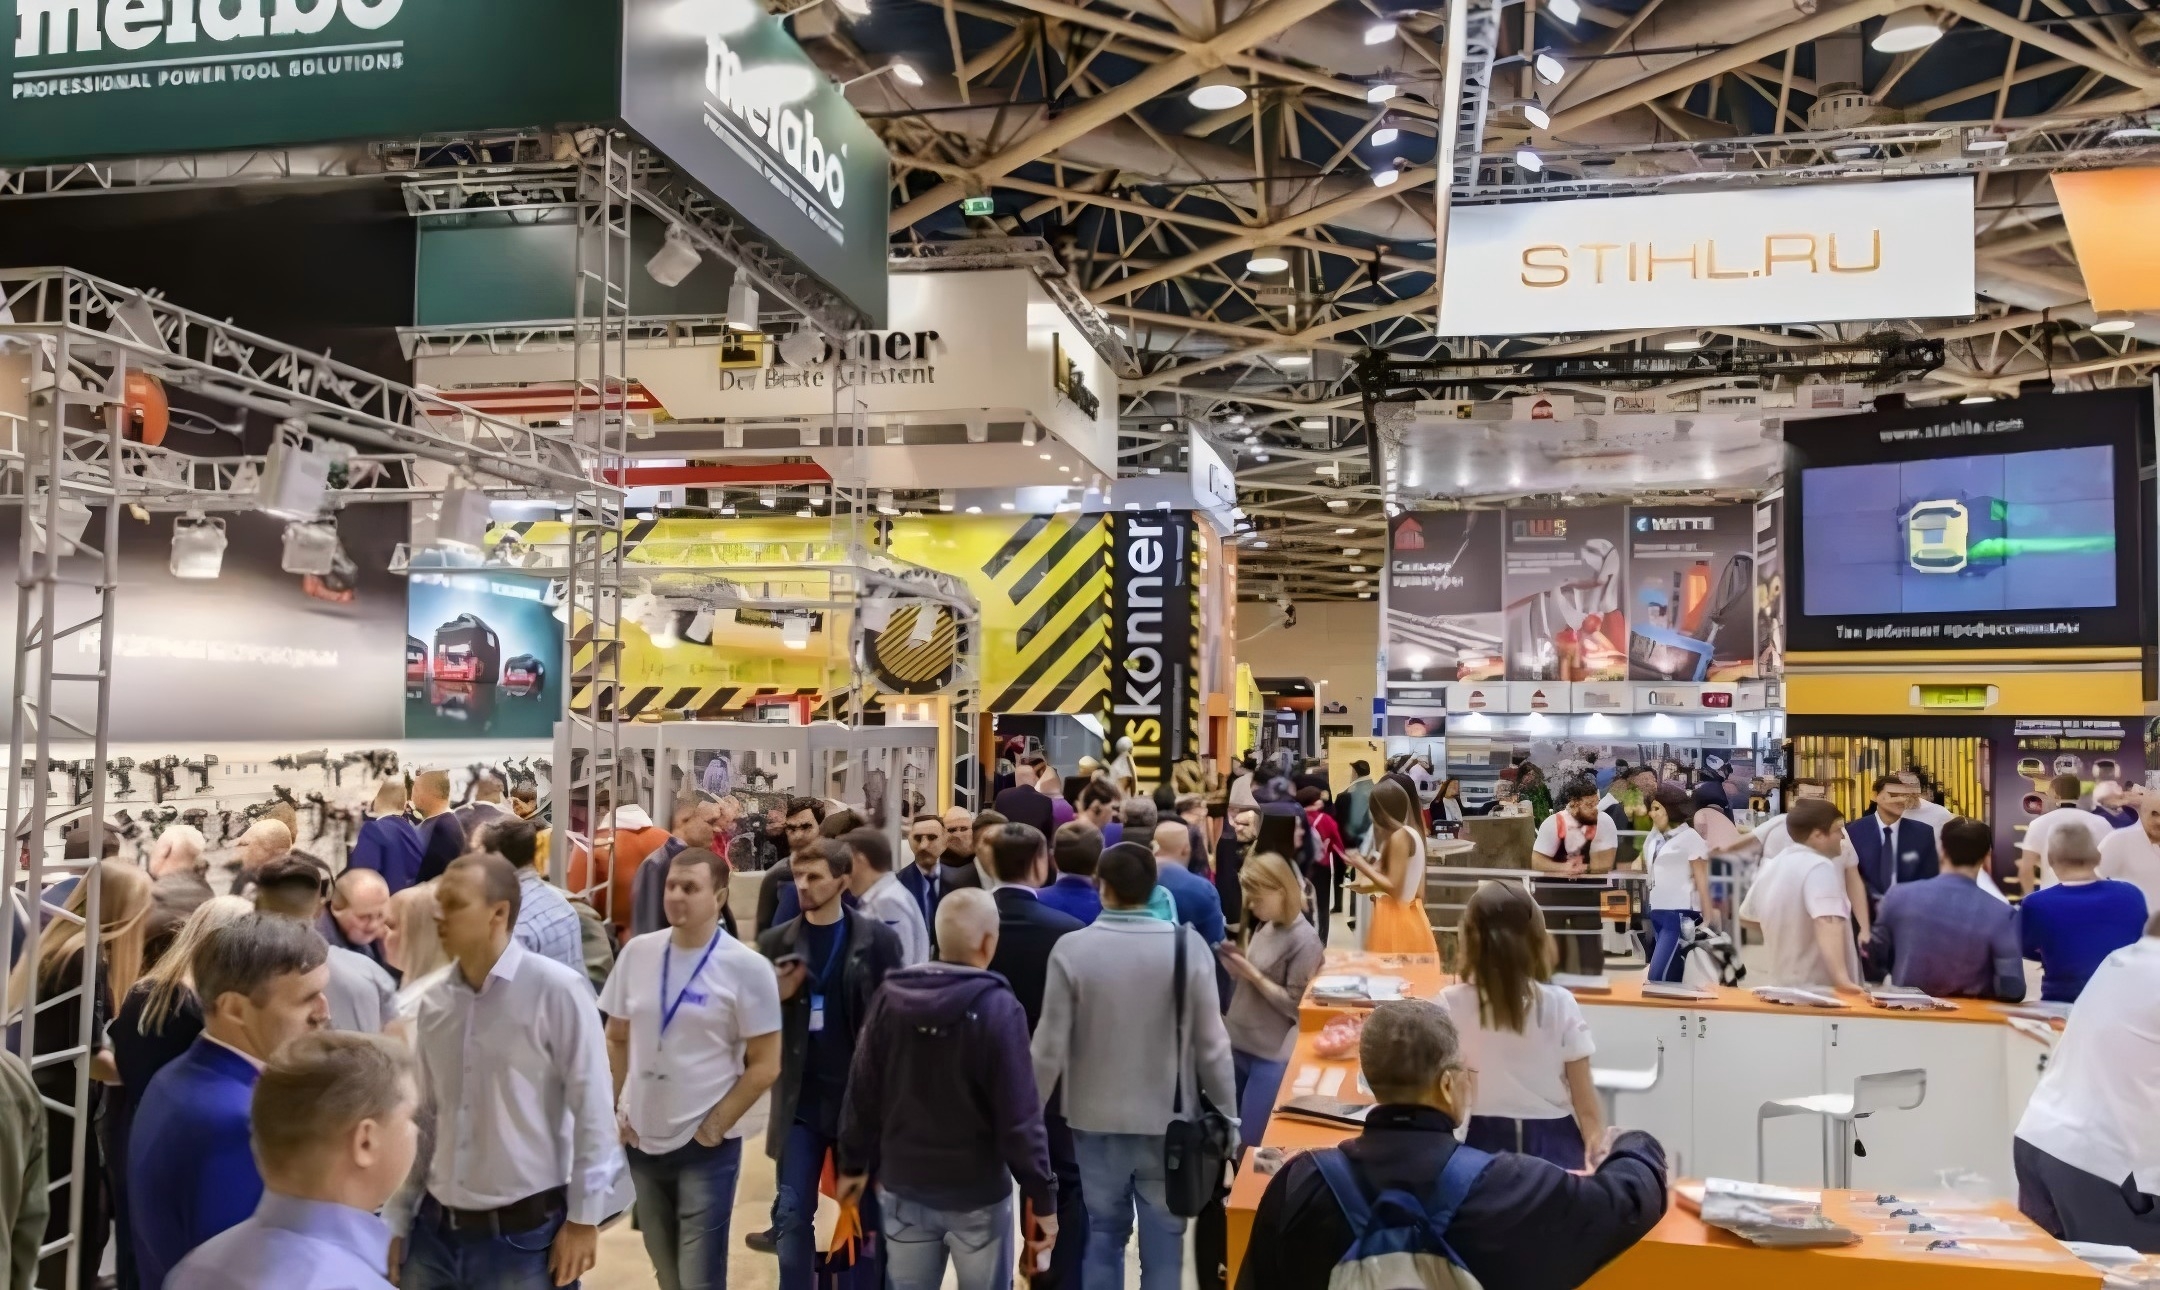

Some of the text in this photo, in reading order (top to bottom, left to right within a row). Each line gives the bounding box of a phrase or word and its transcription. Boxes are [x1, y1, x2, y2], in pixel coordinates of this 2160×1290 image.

[13, 52, 404, 99] PROFESSIONAL POWER TOOL SOLUTIONS
[1521, 229, 1880, 288] STIHL.RU
